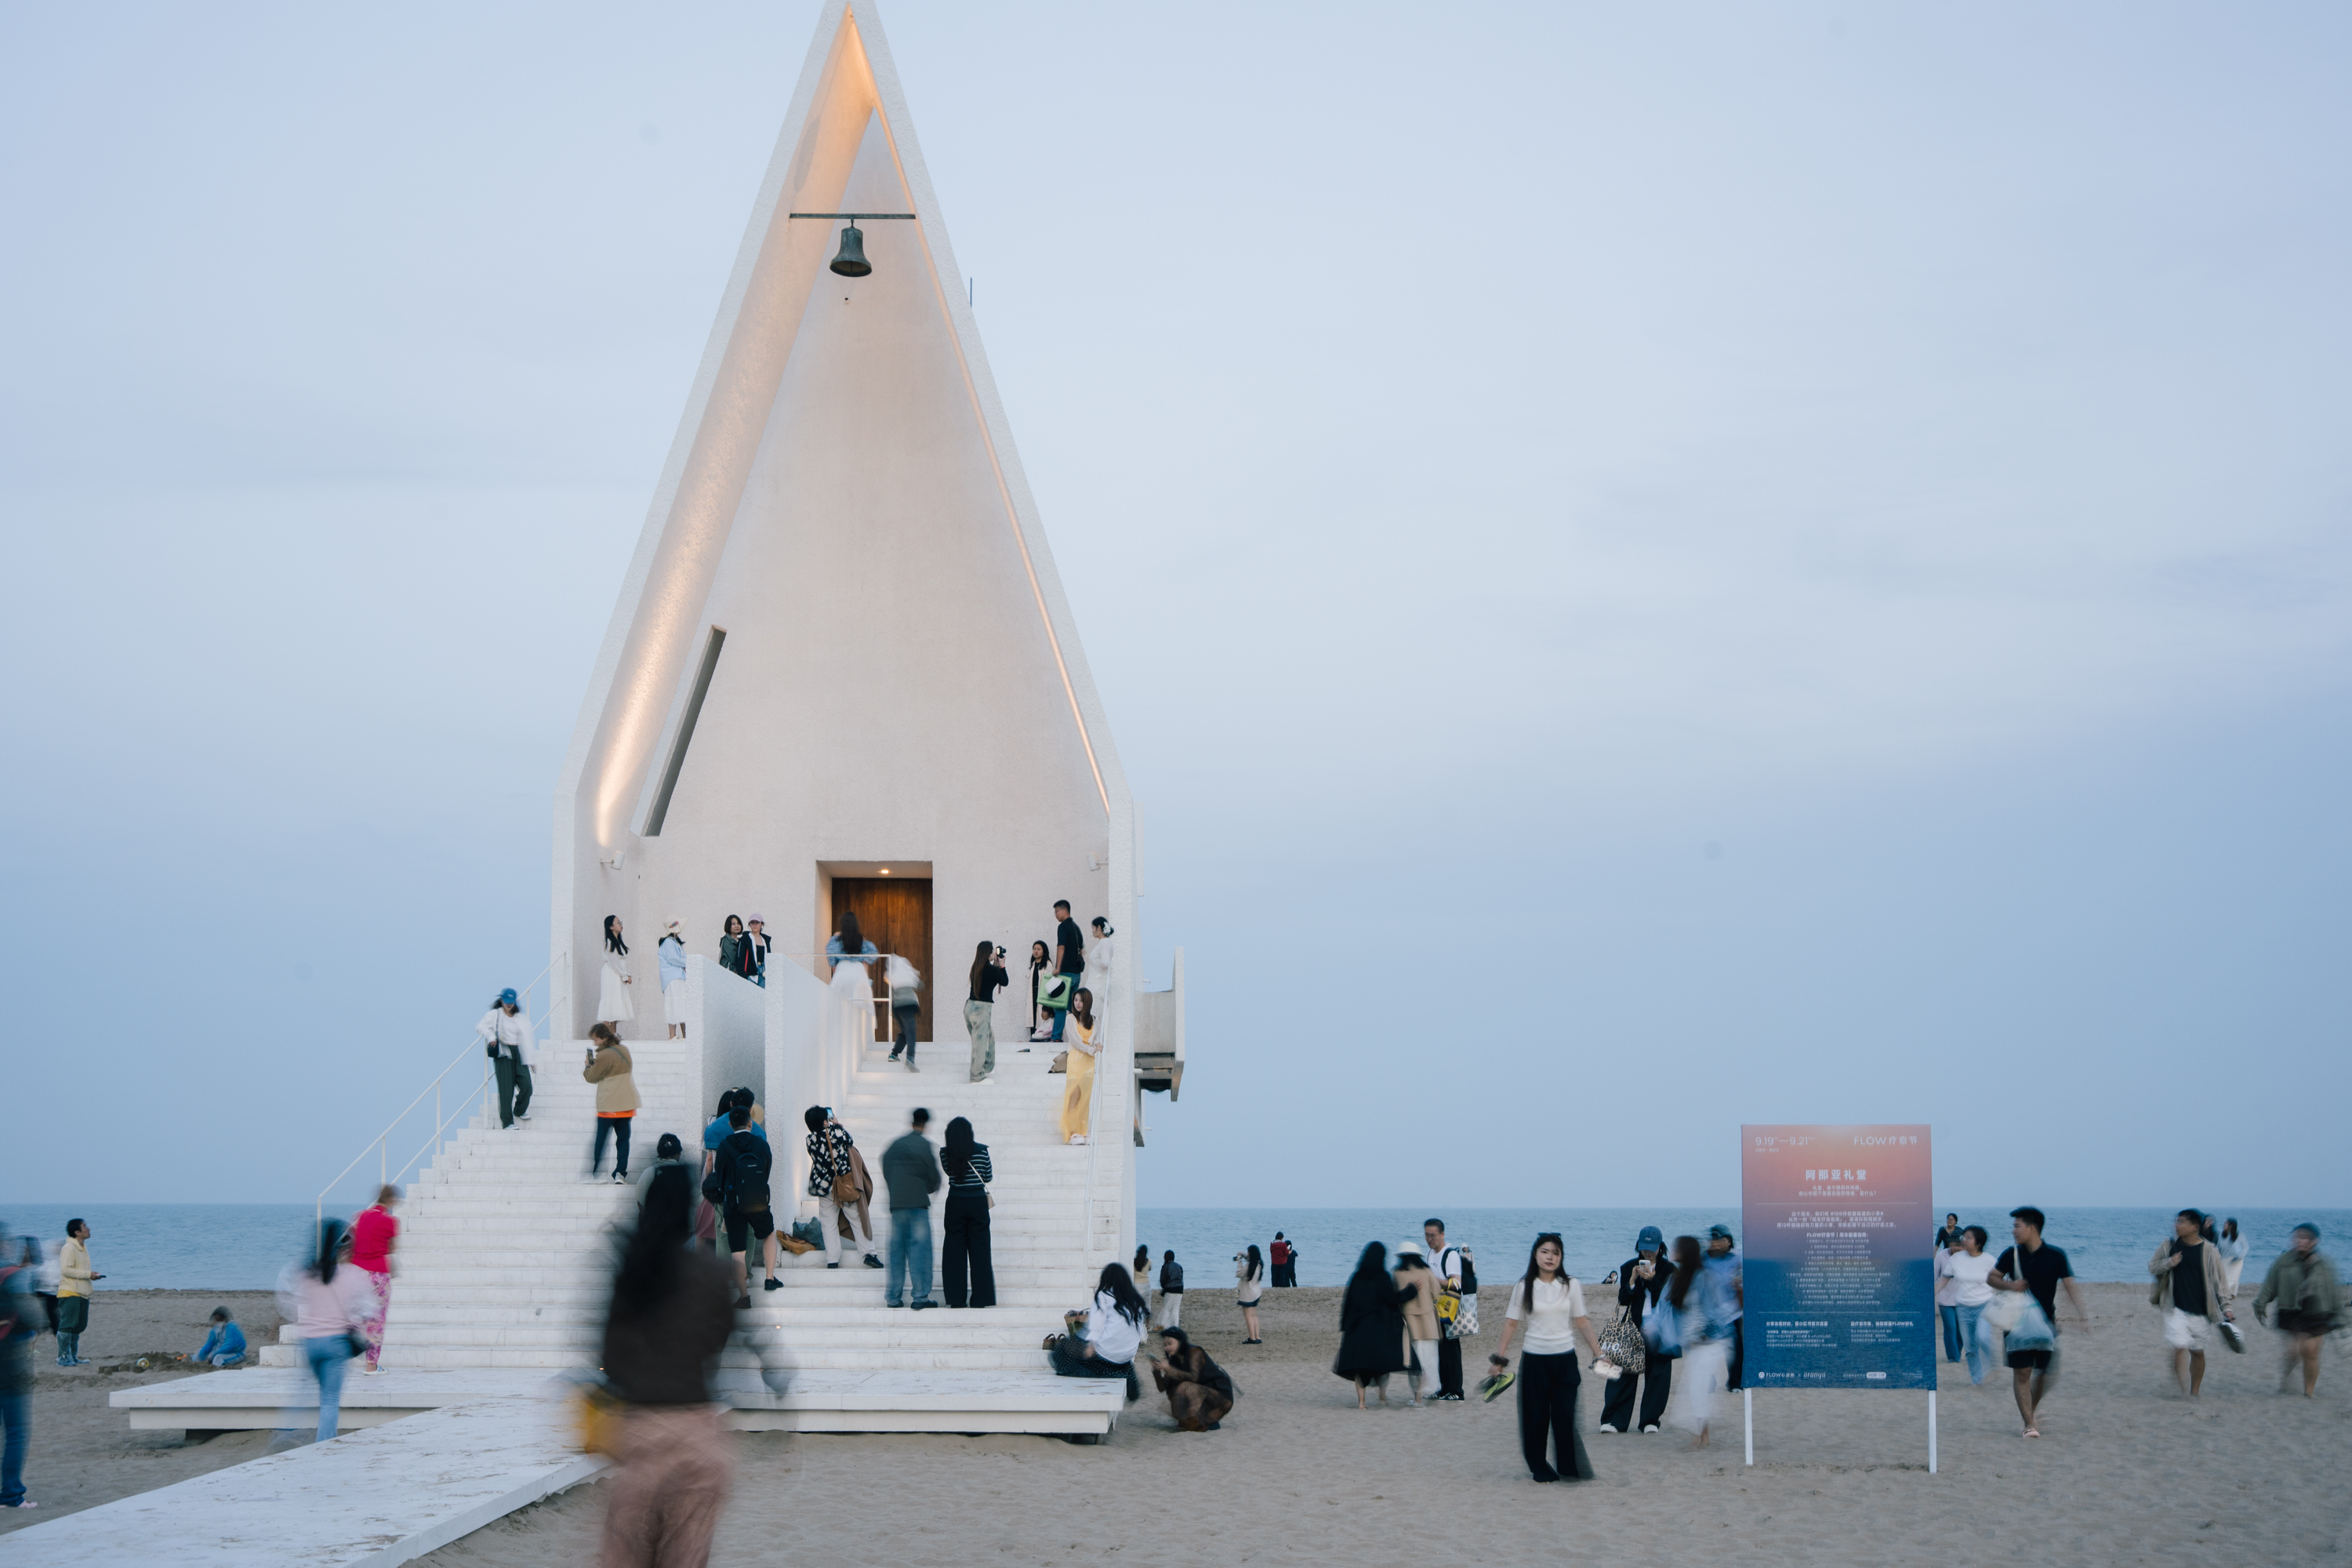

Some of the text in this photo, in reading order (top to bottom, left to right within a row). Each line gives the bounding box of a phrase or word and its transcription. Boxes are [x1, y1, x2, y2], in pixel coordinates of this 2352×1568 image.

[1853, 1135, 1918, 1145] FLOW 疗愈节
[1805, 1169, 1867, 1181] 阿那亚礼堂
